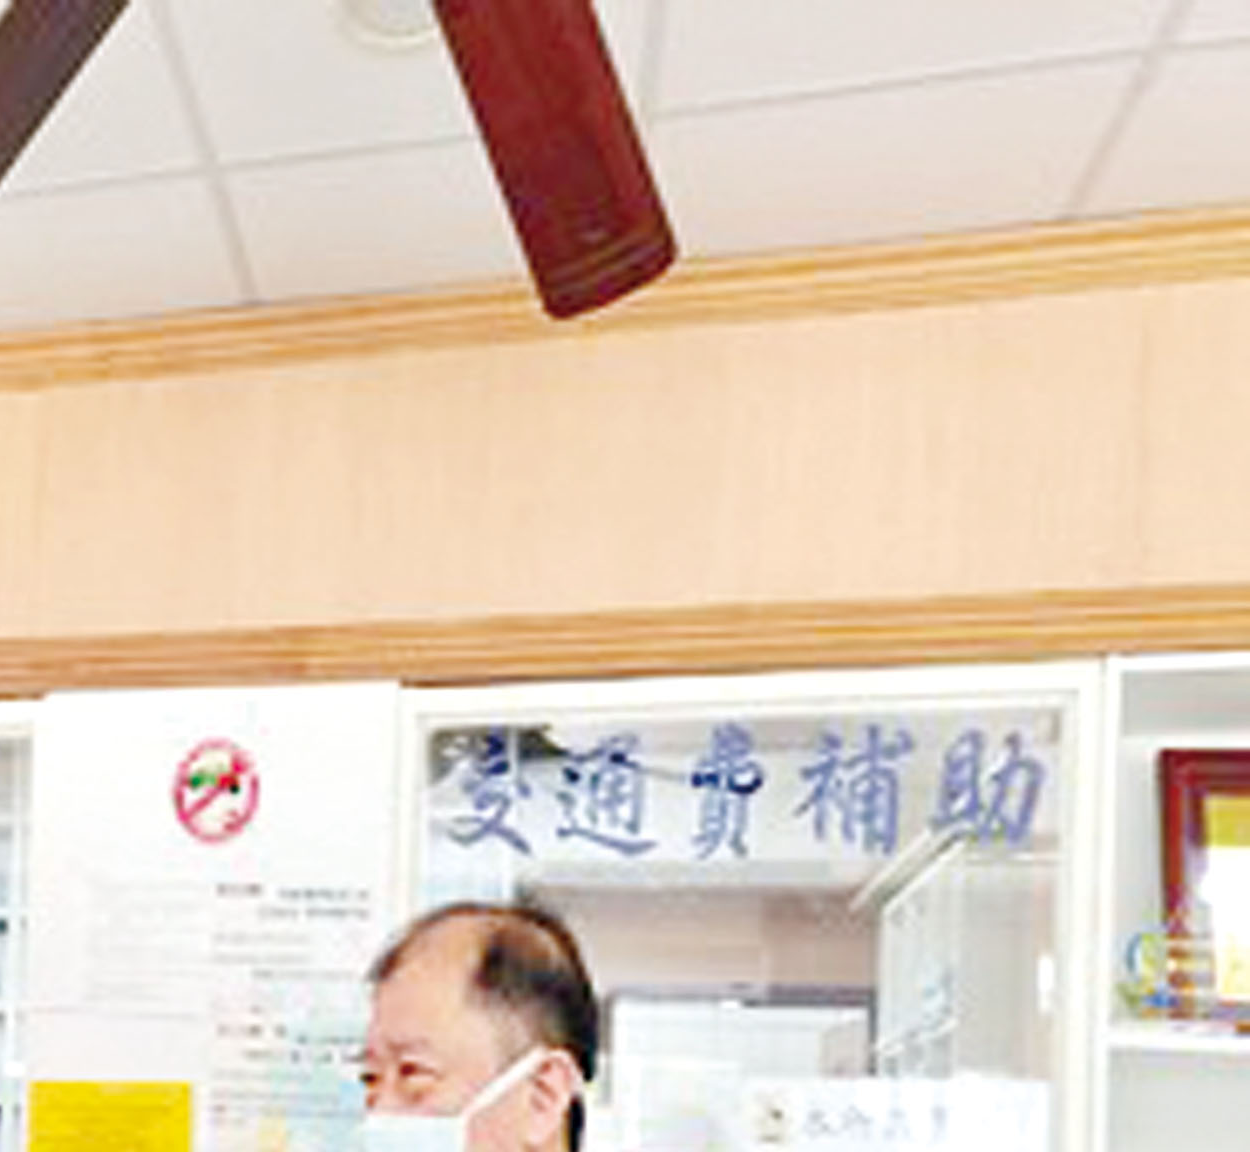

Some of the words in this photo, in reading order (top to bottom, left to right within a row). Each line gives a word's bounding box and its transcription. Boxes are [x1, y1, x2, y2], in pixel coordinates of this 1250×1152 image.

[445, 721, 1047, 858] 交通費補助
